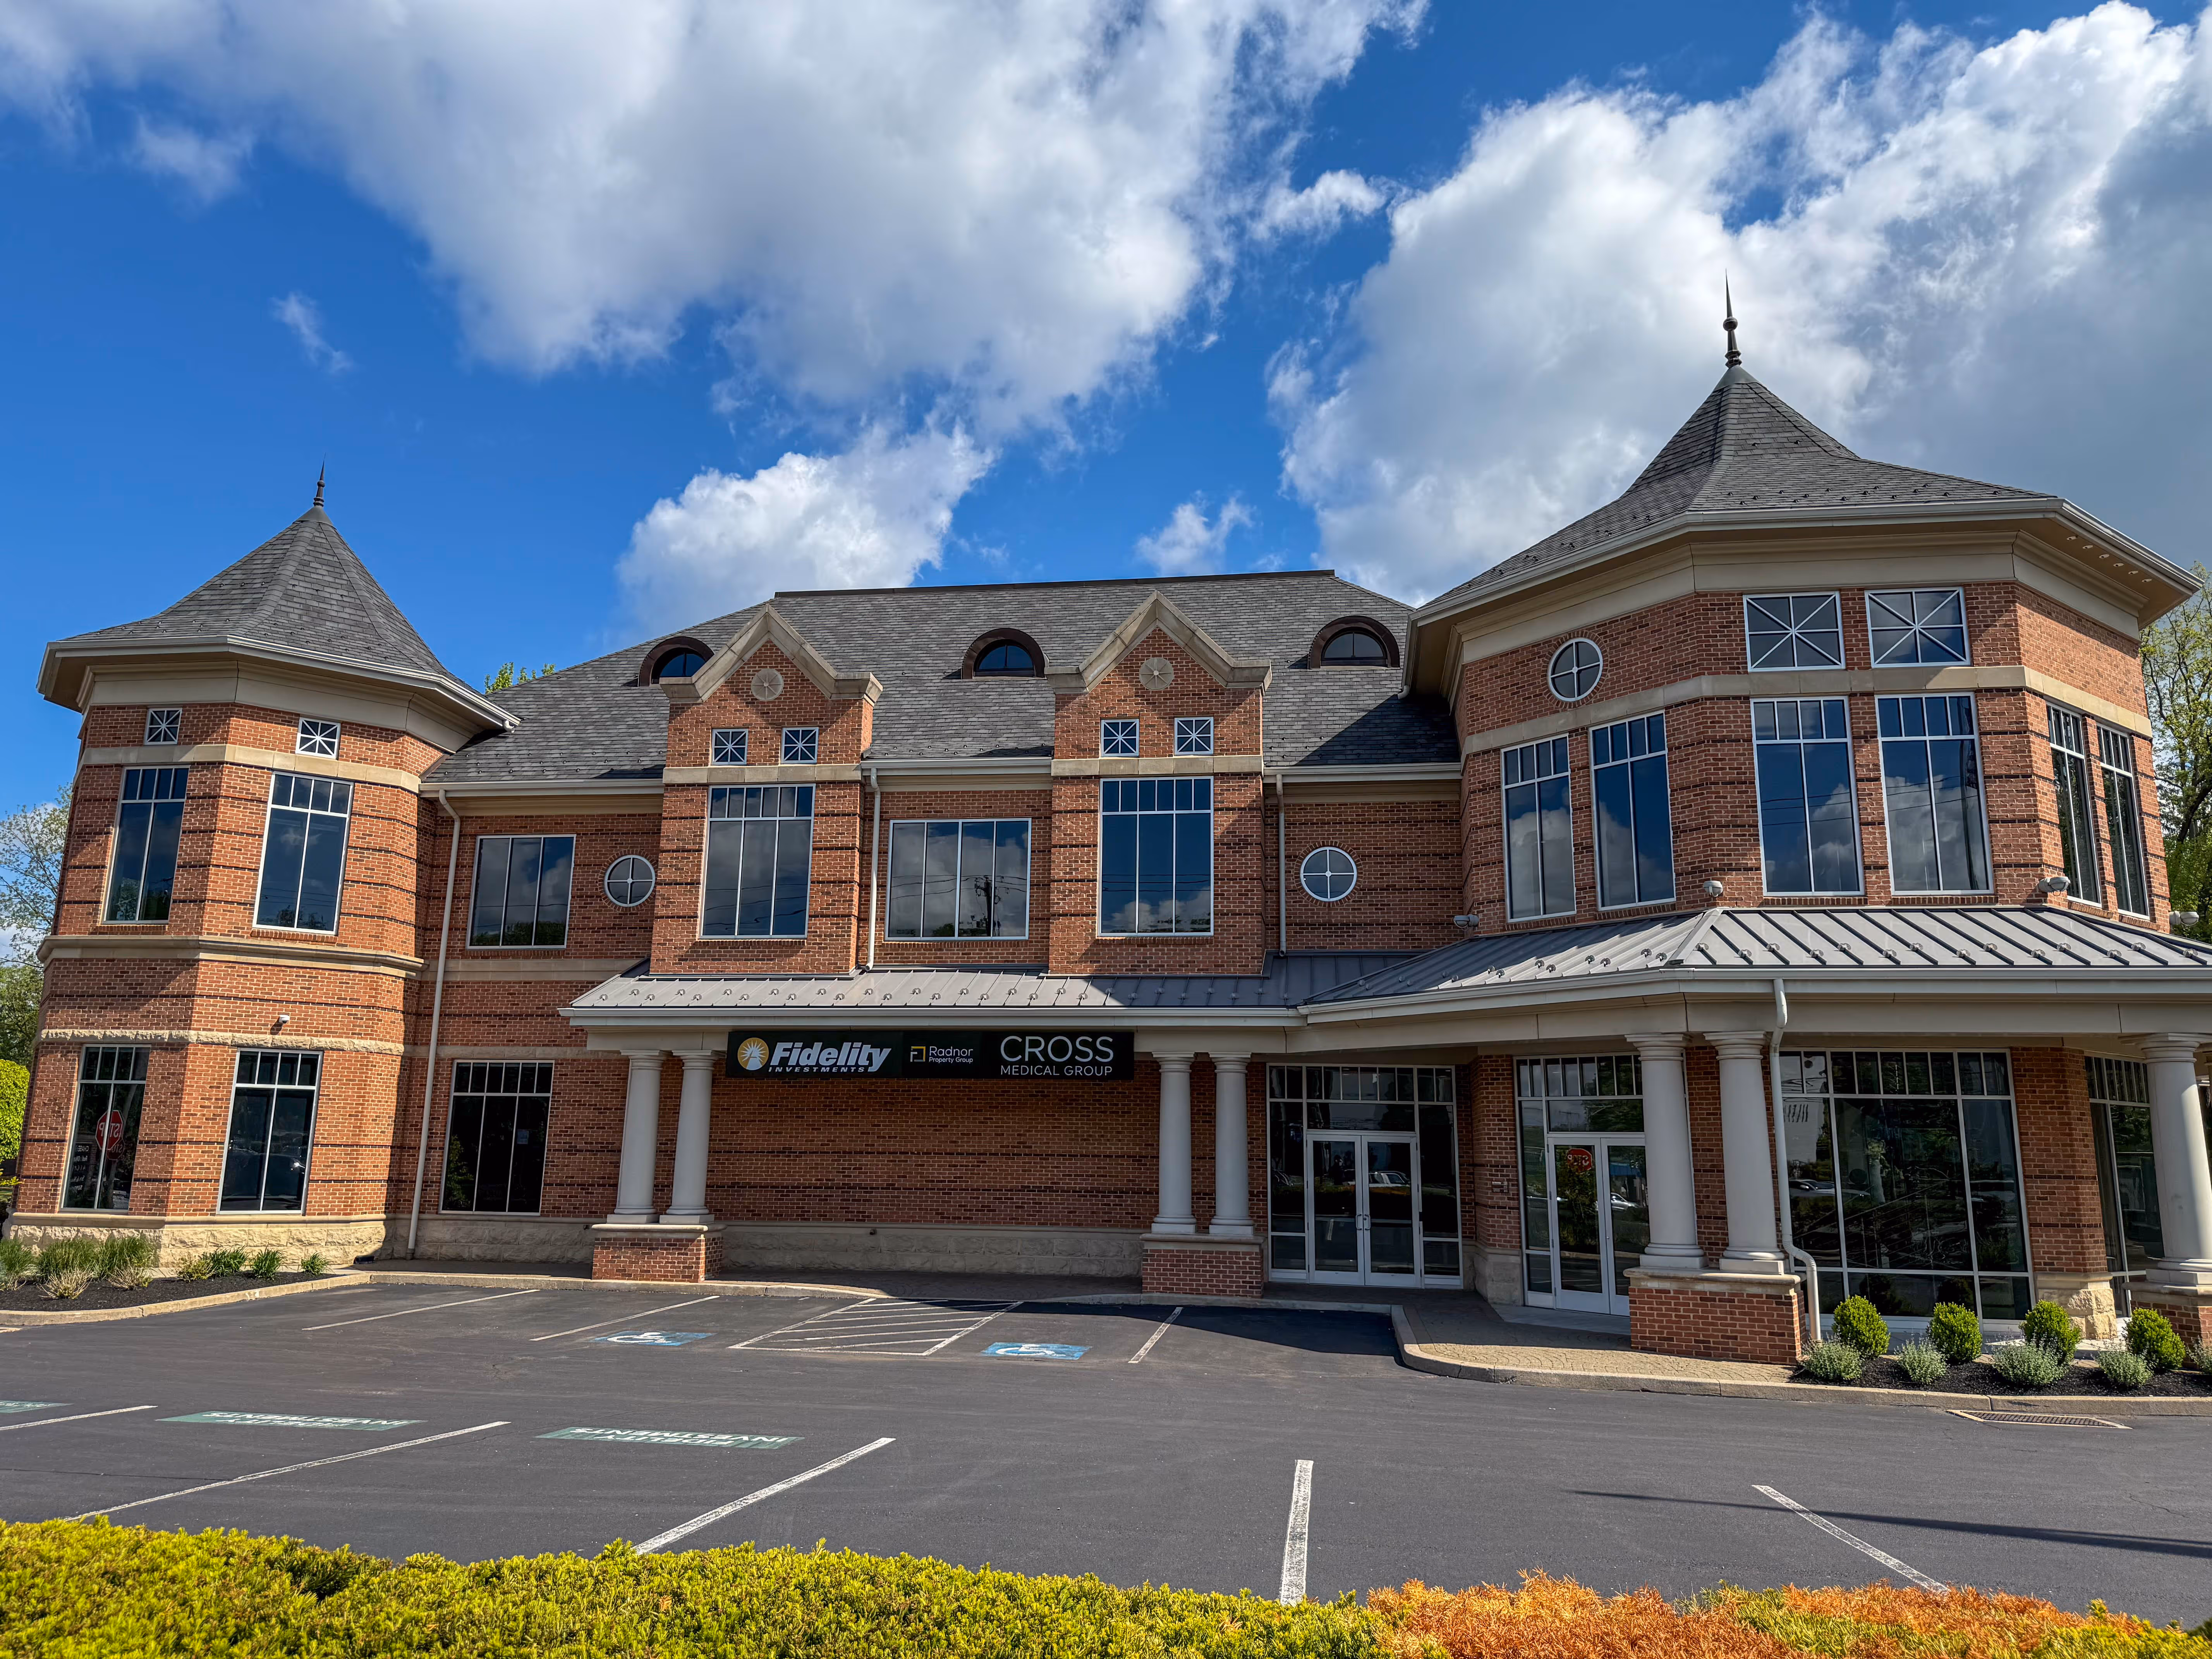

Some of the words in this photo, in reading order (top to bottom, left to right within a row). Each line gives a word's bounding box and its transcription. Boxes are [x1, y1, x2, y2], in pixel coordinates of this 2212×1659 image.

[929, 1046, 973, 1056] Radnor
[1000, 1036, 1114, 1062] CROSS
[770, 1042, 891, 1072] Fidelity
[1001, 1065, 1060, 1075] MEDICAL
[1064, 1065, 1113, 1076] GROUP
[202, 1412, 409, 1425] INVESTMENTS
[570, 1428, 788, 1442] INVESTMENTS
[593, 1435, 734, 1445] FIDELITY
